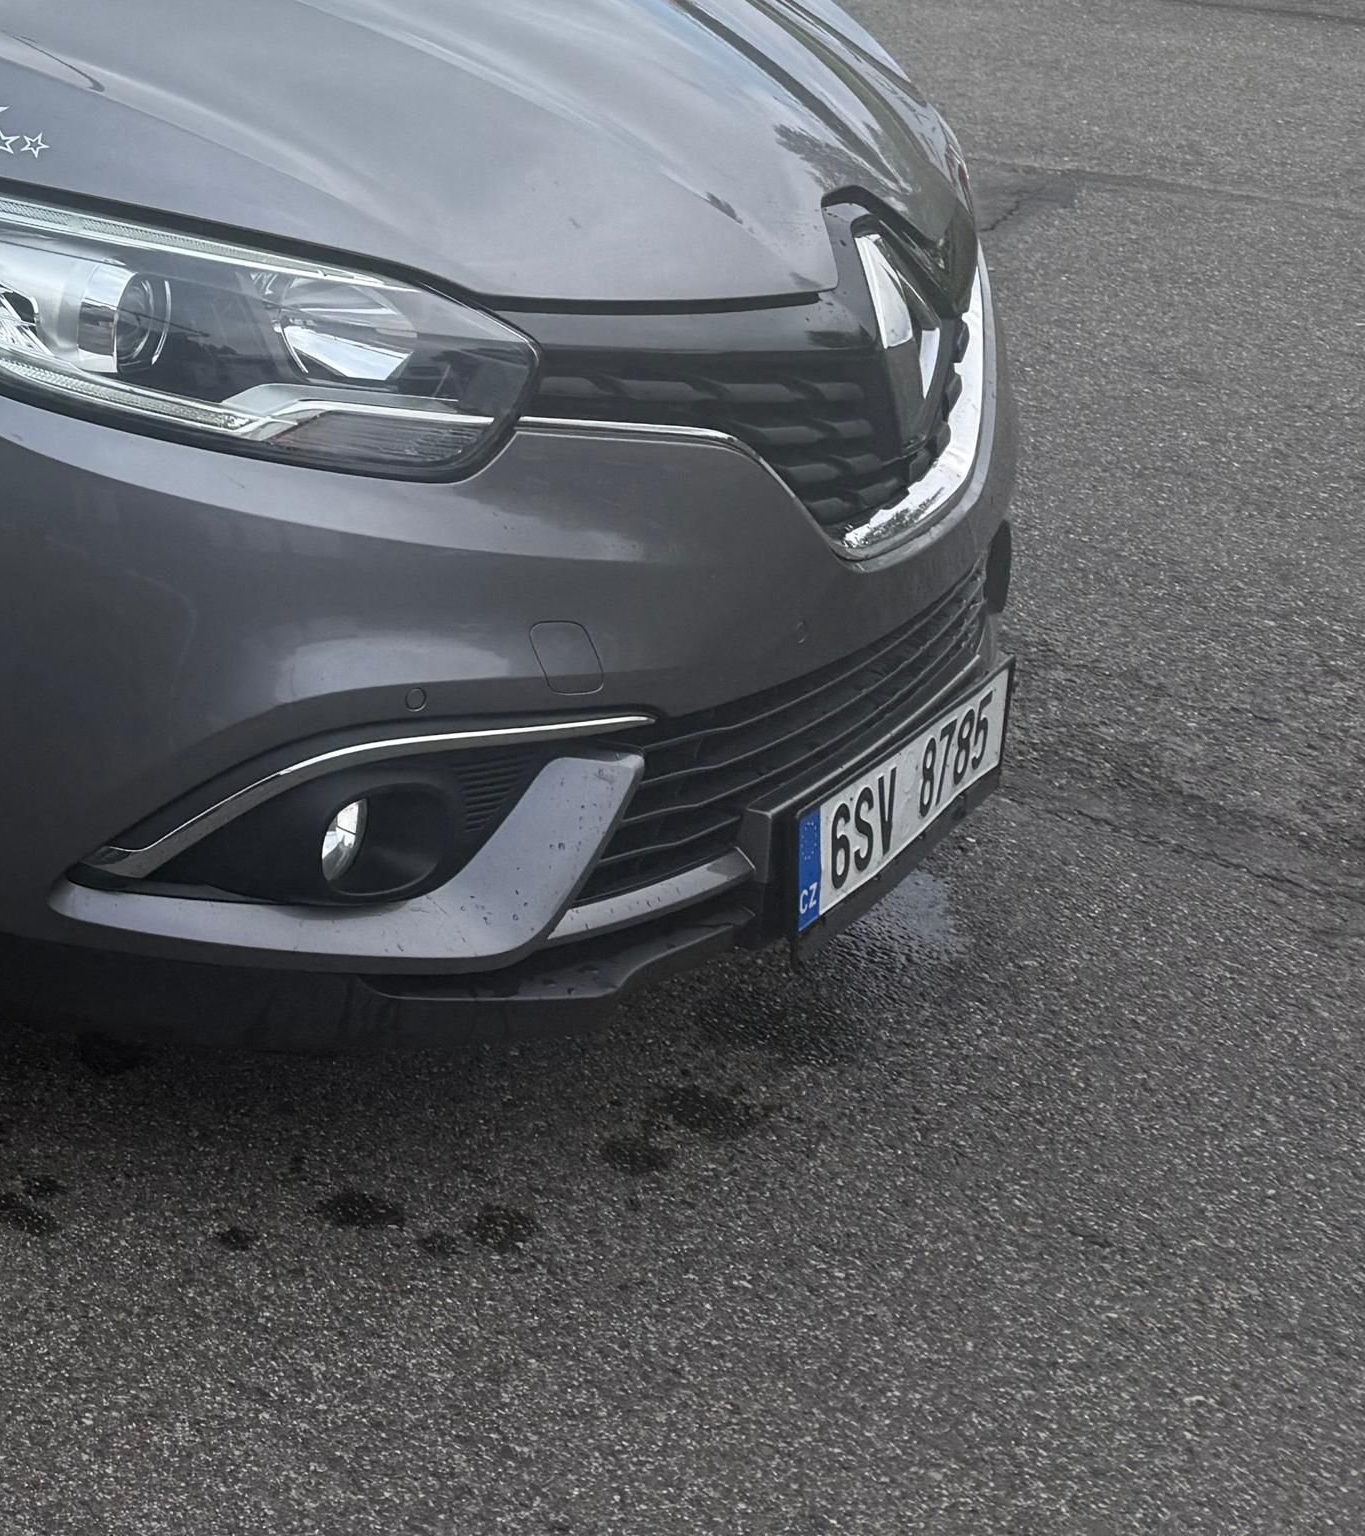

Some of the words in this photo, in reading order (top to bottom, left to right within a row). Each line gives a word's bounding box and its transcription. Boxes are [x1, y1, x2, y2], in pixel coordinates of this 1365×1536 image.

[830, 766, 898, 890] 6SV
[918, 690, 994, 819] 8785
[798, 881, 818, 916] CZ
